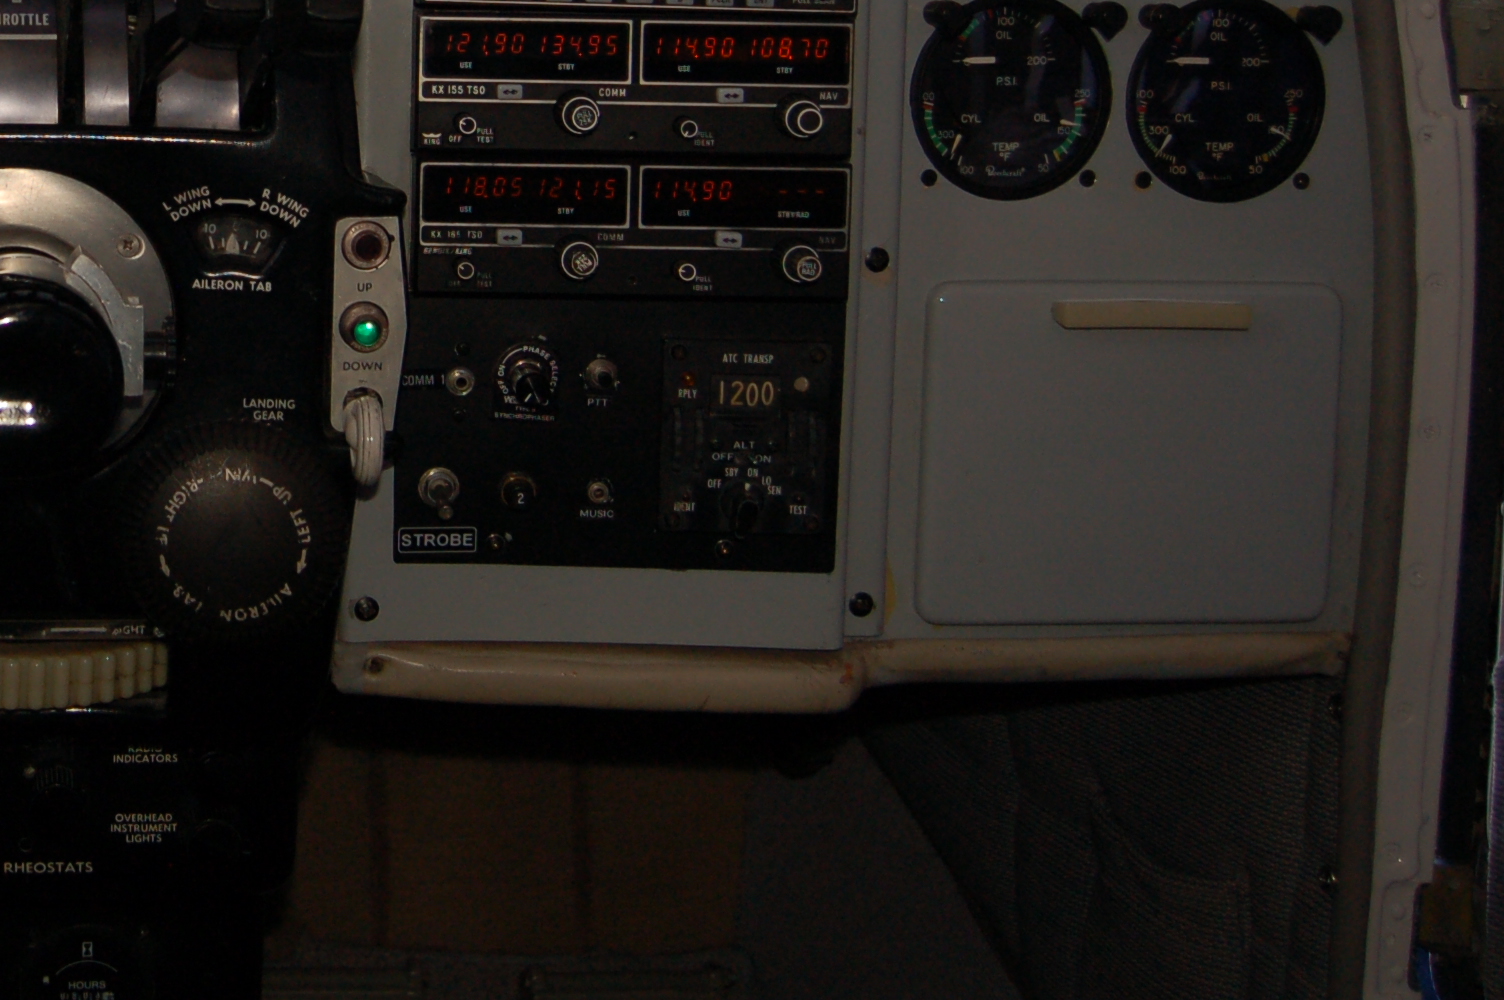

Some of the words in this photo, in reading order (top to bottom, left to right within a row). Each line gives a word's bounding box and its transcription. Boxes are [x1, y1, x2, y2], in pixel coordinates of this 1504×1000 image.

[997, 17, 1015, 26] 100
[1212, 18, 1231, 28] 100
[996, 31, 1012, 40] OIL
[1210, 32, 1227, 41] OIL
[446, 33, 525, 56] 121.90
[541, 34, 618, 57] 134.95
[656, 37, 736, 59] 114.90
[750, 37, 830, 60] 108.70
[1026, 56, 1047, 65] 200
[431, 85, 445, 95] KX
[447, 85, 464, 95] 155
[467, 85, 486, 95] TSO
[598, 88, 626, 97] COMM
[819, 91, 838, 101] NAV
[960, 114, 981, 123] CYL
[1034, 113, 1050, 122] OIL
[1174, 114, 1195, 122] CYL
[1246, 113, 1264, 122] OIL
[992, 142, 1020, 151] TEMP
[1205, 142, 1234, 151] TEMP
[1169, 166, 1187, 175] 100
[446, 176, 523, 199] 118.05
[539, 177, 617, 200] 121.15
[654, 180, 733, 202] 114.90
[162, 201, 171, 212] L
[173, 185, 211, 205] WING
[262, 188, 270, 199] R
[277, 192, 310, 219] WING
[170, 198, 213, 222] DOWN
[259, 201, 301, 229] DOWN
[597, 233, 624, 241] COMM
[818, 236, 836, 245] NAV
[192, 279, 244, 291] AILERON
[249, 281, 273, 292] TAB
[357, 282, 372, 292] UP
[722, 353, 738, 363] ATC
[743, 353, 774, 364] TRANSP
[342, 361, 383, 371] DOWN
[719, 380, 775, 407] 1200
[243, 398, 296, 409] LANDING
[253, 410, 284, 421] GEAR
[732, 441, 755, 449] ALT
[711, 452, 734, 461] OFF
[579, 510, 615, 518] MUSIC
[789, 505, 807, 514] TEST
[401, 532, 474, 547] STROBE
[112, 754, 178, 764] INDICATORS
[115, 812, 173, 822] OVERHEAD
[110, 823, 178, 833] INSTRUMENT
[125, 834, 163, 844] LIGHTS
[3, 861, 94, 874] RHEOSTATS
[68, 980, 106, 990] HOURS
